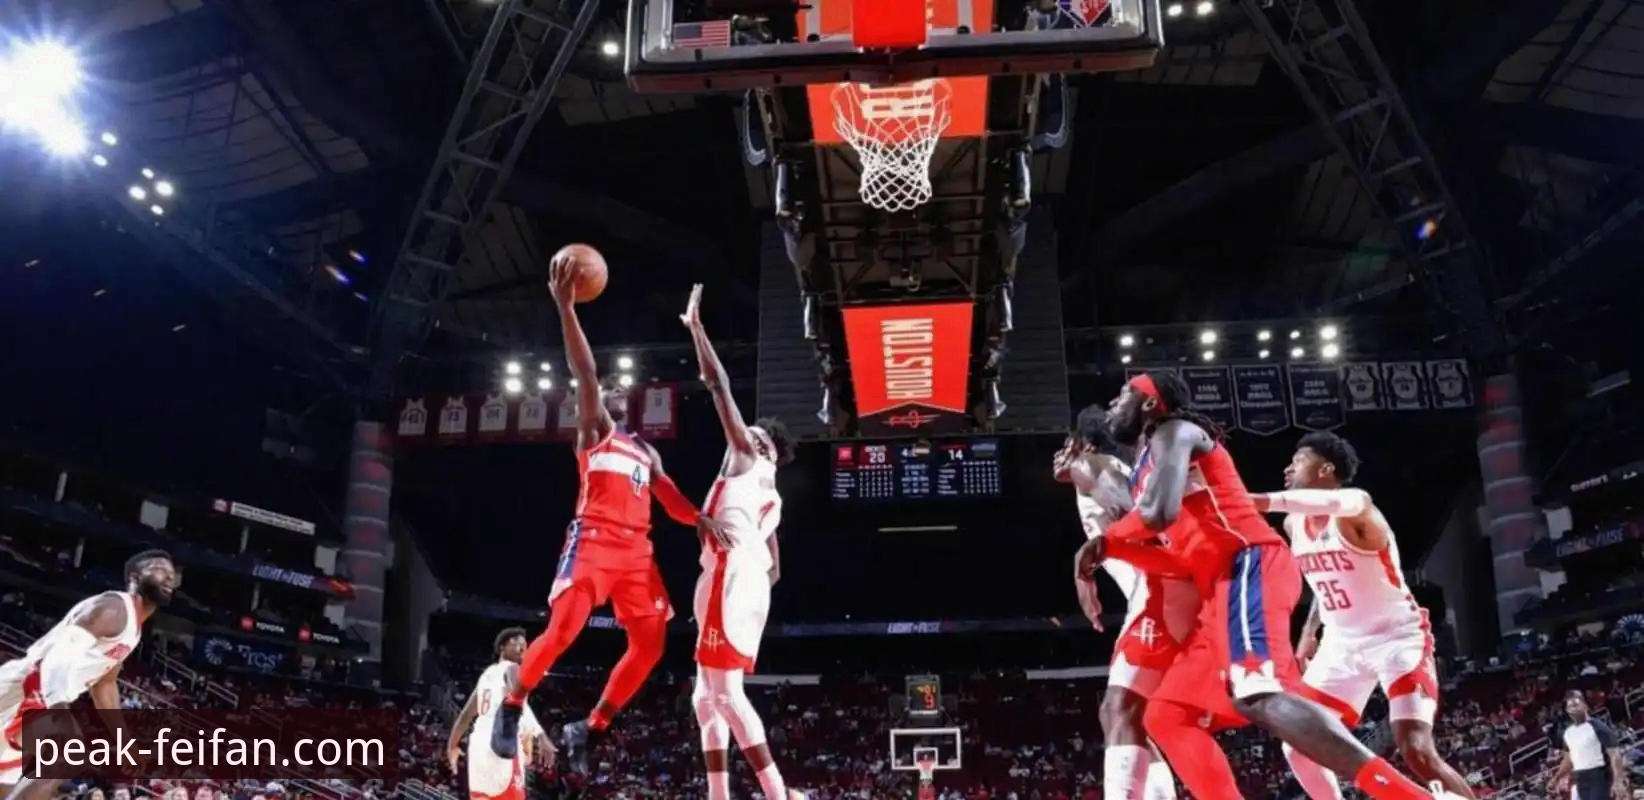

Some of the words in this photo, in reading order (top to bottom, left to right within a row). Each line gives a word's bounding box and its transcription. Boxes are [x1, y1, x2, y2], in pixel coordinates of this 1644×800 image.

[880, 317, 934, 400] HOUSTON
[869, 452, 886, 464] 20
[948, 449, 964, 461] 14
[1316, 579, 1352, 611] 35
[256, 621, 285, 633] TOYOTA
[887, 621, 913, 634] LIGHT
[918, 621, 940, 634] FUSE
[312, 632, 340, 644] TOYOTA
